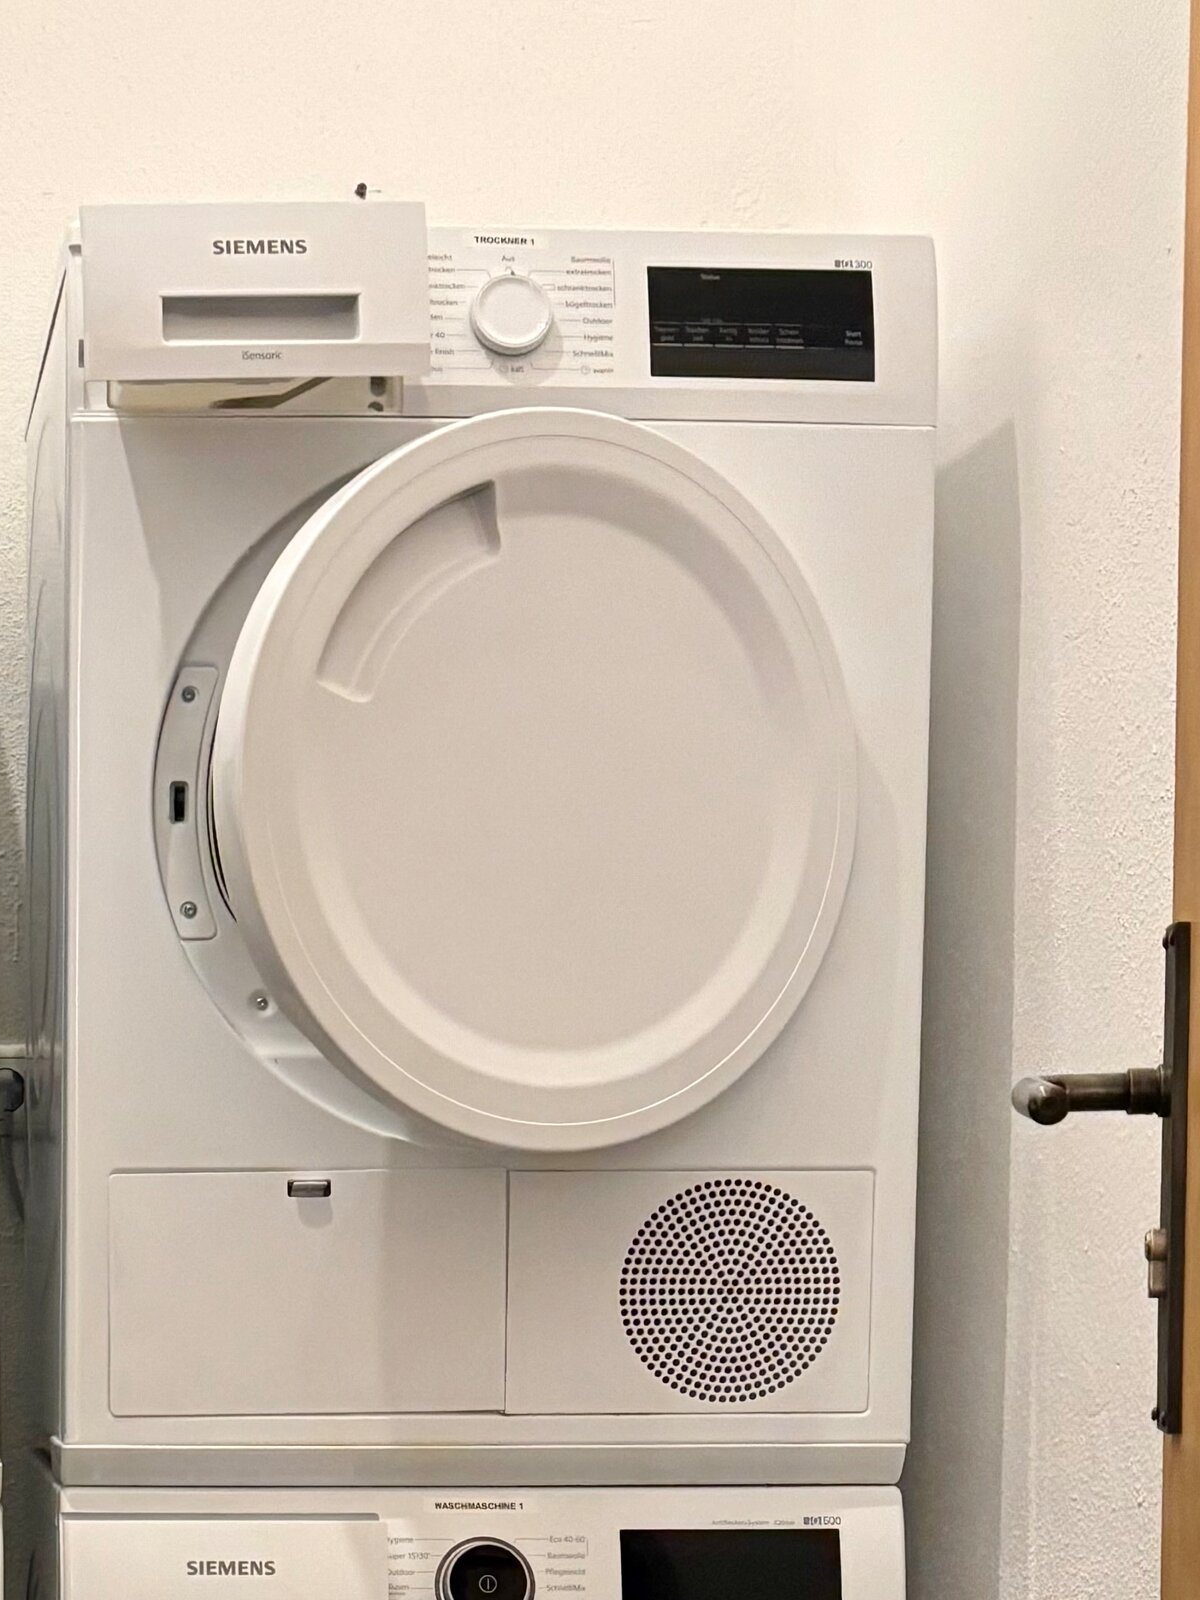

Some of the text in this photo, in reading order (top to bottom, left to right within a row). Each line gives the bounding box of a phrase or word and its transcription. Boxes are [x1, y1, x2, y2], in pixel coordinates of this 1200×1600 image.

[473, 235, 527, 245] TROCKNER
[212, 239, 308, 255] SIEMENS
[241, 350, 283, 360] iSensoric
[434, 1502, 516, 1510] WASCHMASCHINE
[186, 1560, 276, 1576] SIEMENS
